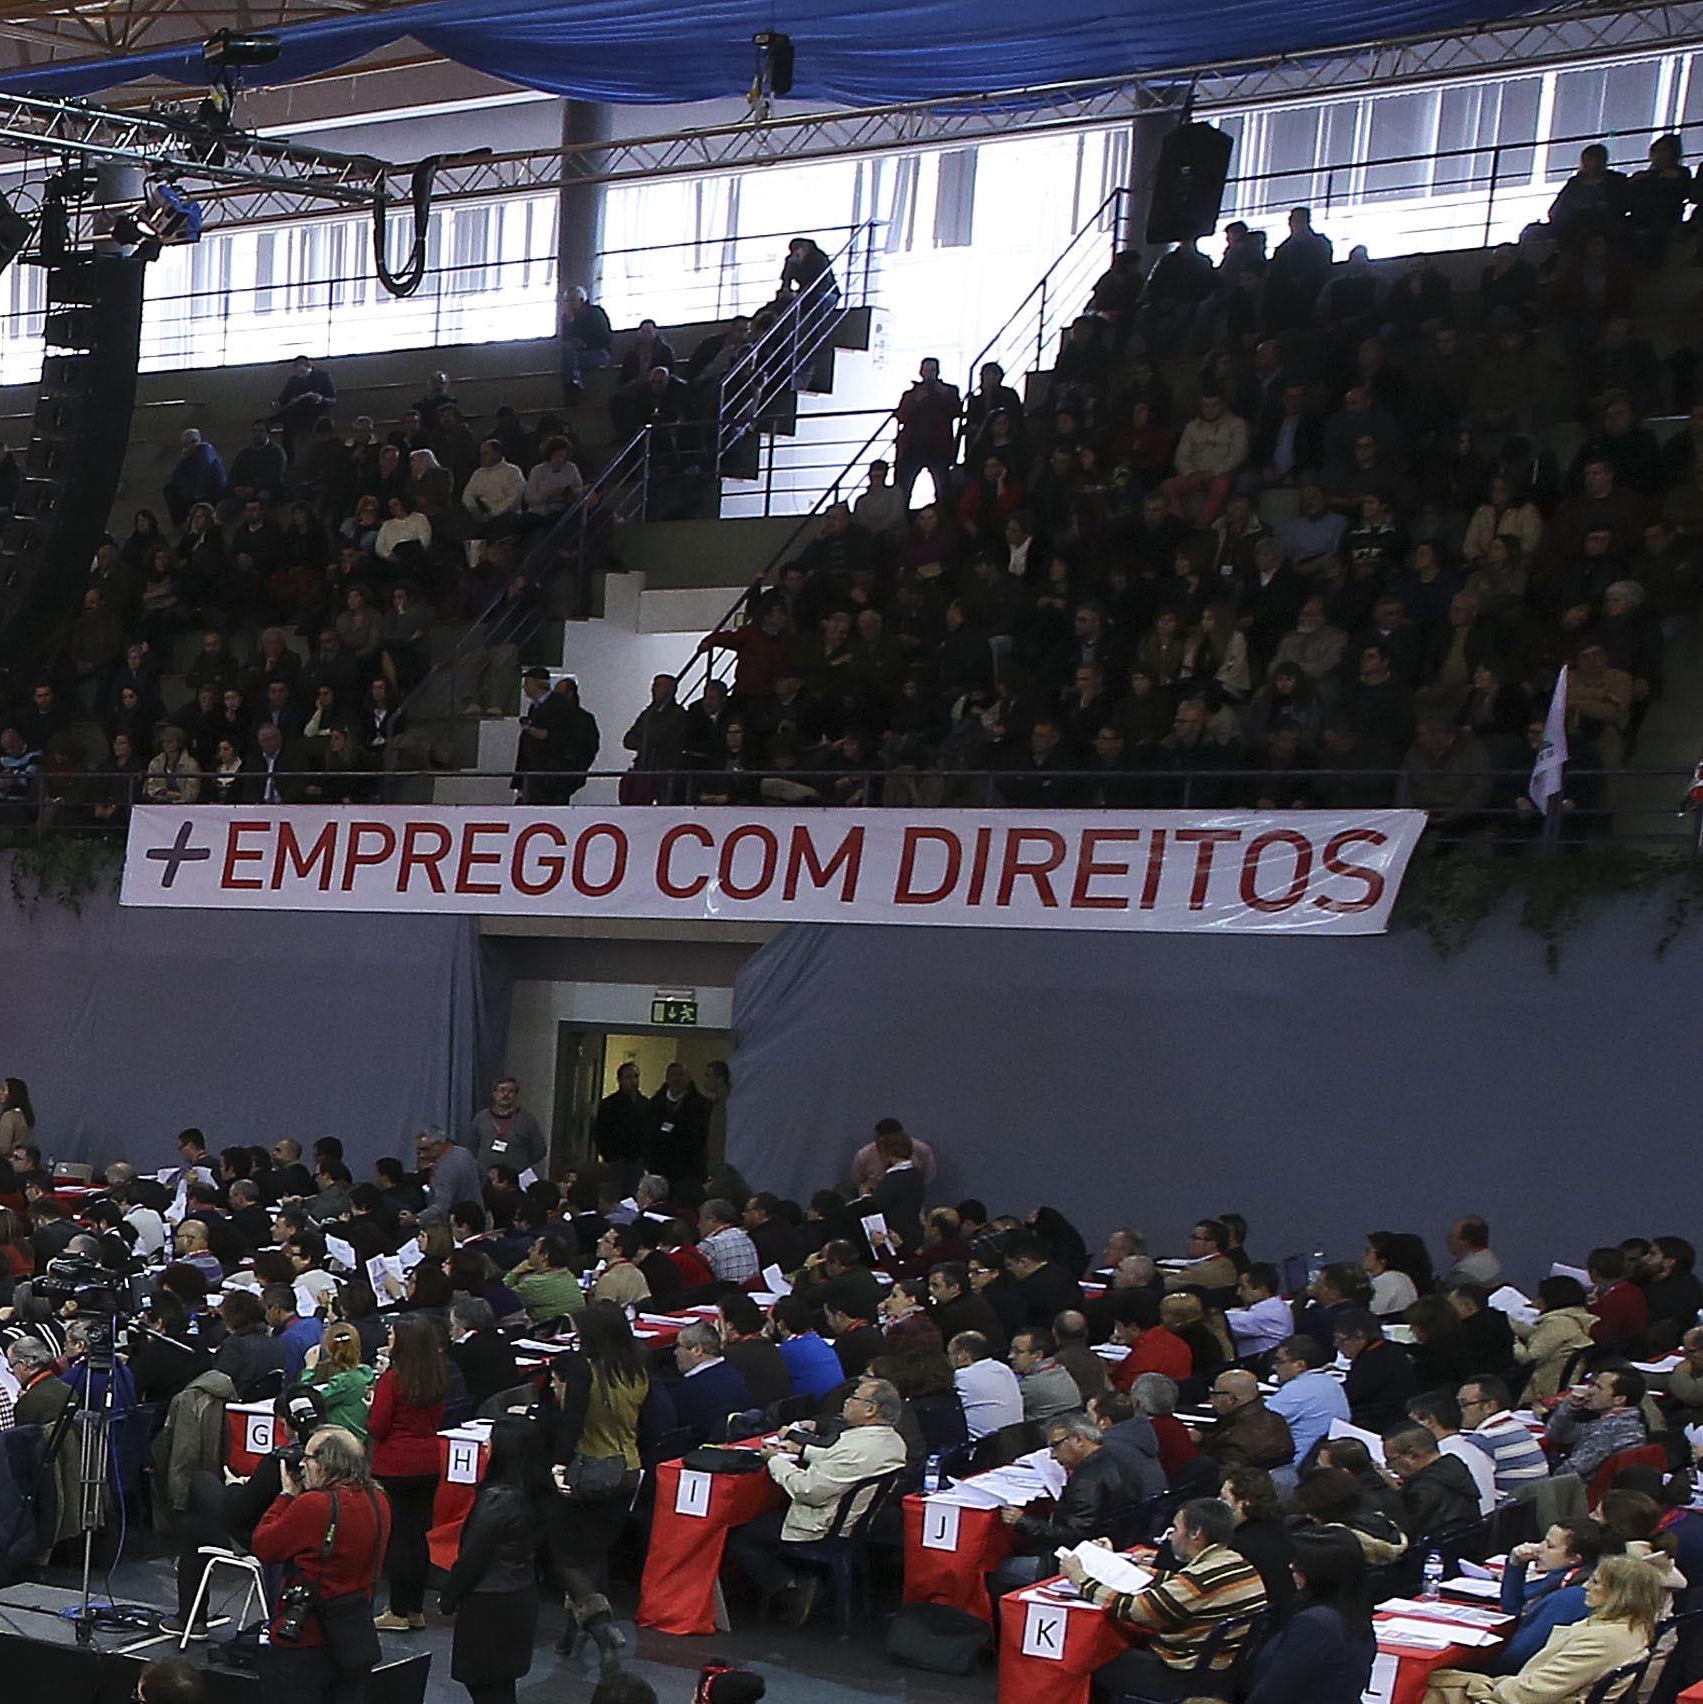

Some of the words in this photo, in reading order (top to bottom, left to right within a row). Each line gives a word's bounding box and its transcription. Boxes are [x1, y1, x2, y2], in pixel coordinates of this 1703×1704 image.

[657, 823, 866, 901] COM
[894, 826, 1388, 914] DIREITOS
[253, 1424, 269, 1446] G
[454, 1448, 471, 1472] H
[690, 1479, 697, 1503] I
[935, 1516, 946, 1540] J
[1036, 1618, 1058, 1648] K
